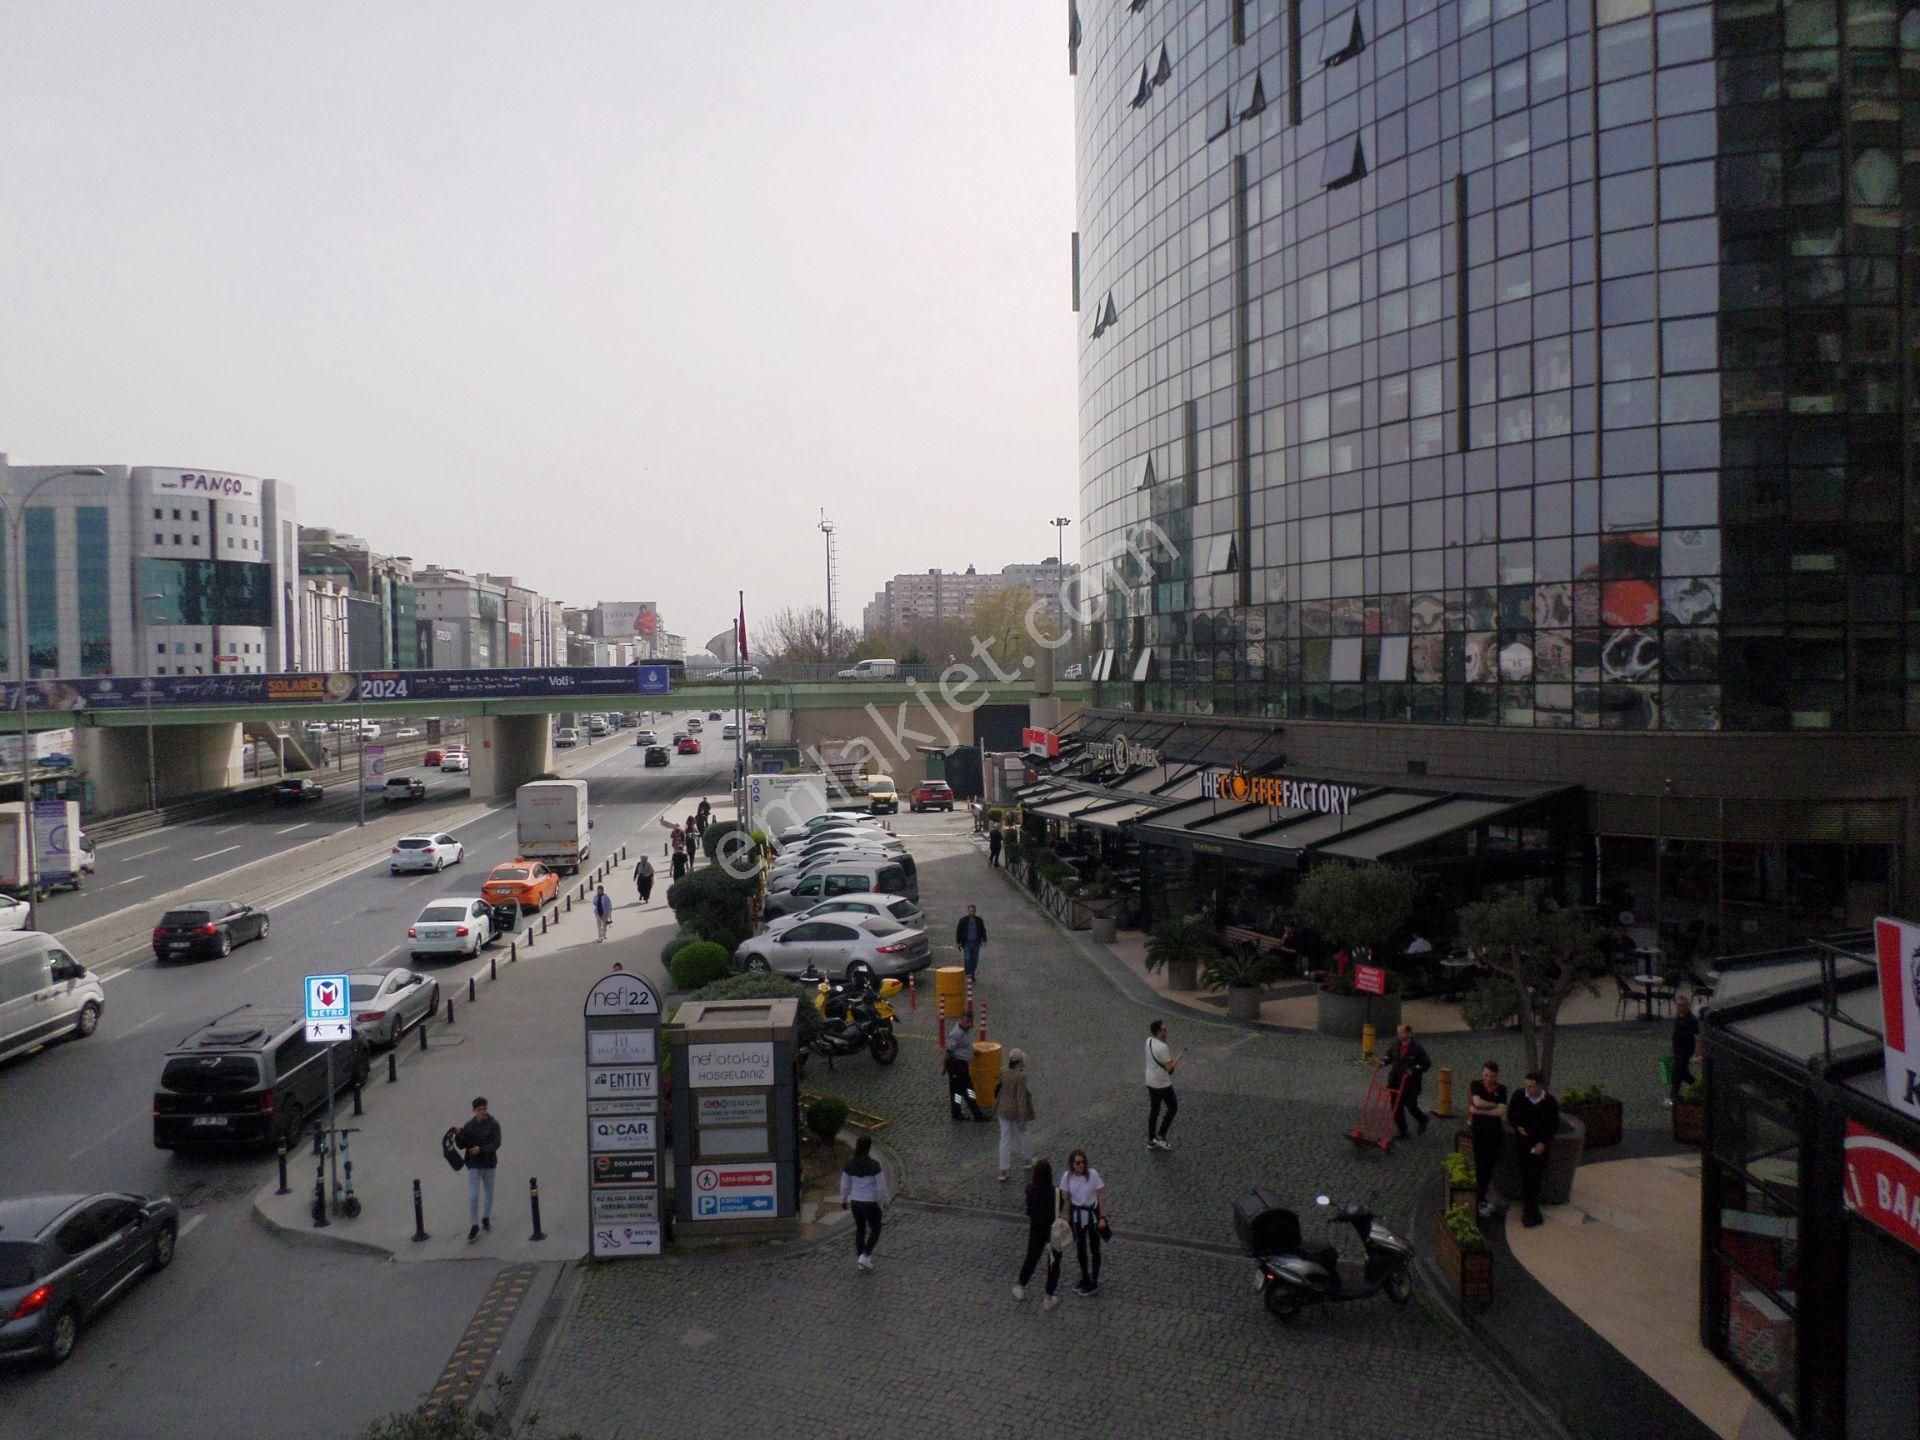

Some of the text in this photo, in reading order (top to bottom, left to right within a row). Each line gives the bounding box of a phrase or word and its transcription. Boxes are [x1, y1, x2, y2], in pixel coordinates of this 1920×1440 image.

[181, 474, 242, 496] PANÇO
[362, 680, 408, 698] 2024
[1196, 771, 1221, 799] THE
[1282, 779, 1352, 816] FACTORY
[594, 986, 649, 1007] nef 22
[311, 1009, 345, 1017] METRO
[609, 1072, 651, 1088] ENTITY
